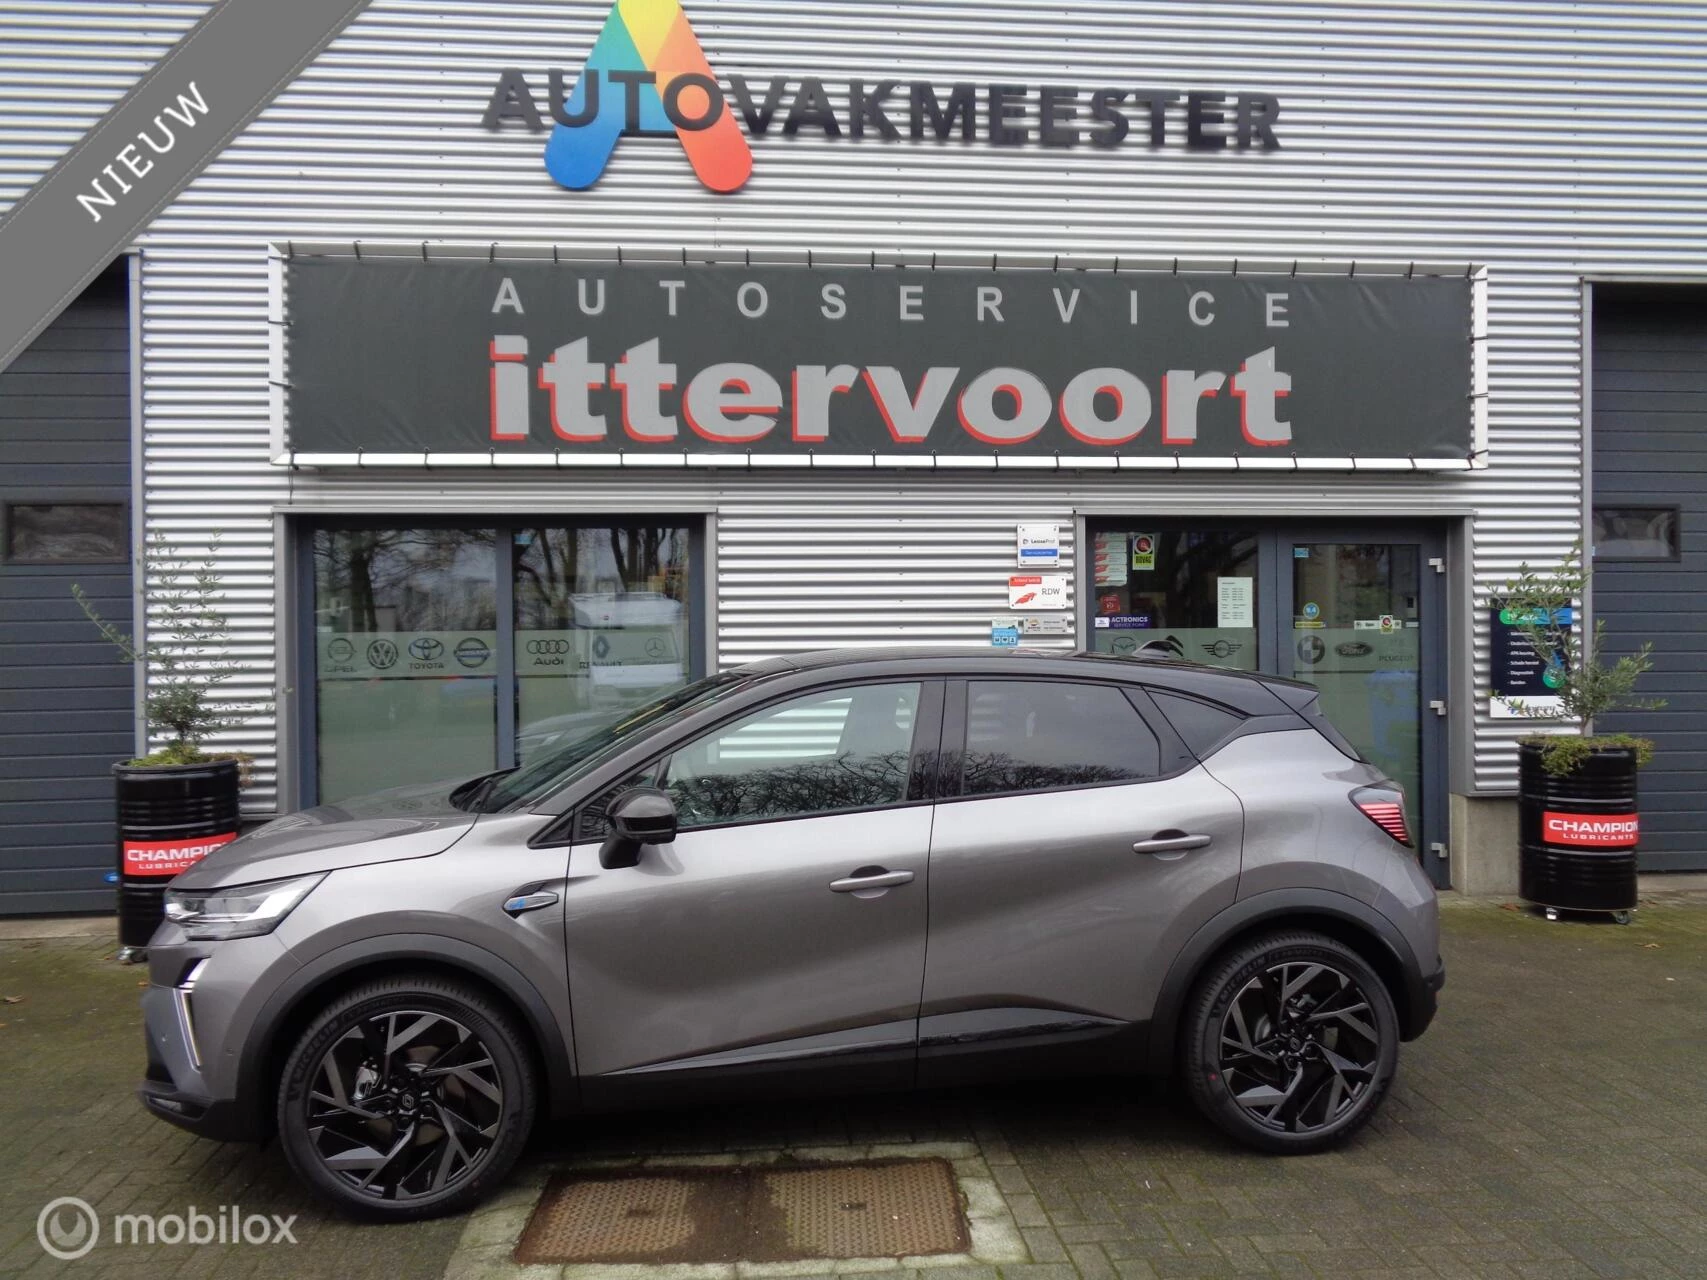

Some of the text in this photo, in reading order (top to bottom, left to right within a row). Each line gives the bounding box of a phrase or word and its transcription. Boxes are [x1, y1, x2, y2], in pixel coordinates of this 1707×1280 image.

[481, 67, 1281, 151] AUTOVAKMEESTER
[491, 277, 1290, 327] AUTOSERVICE
[489, 334, 1293, 447] ittervoort
[1041, 587, 1060, 595] RDW
[408, 662, 445, 670] TOYOTA
[533, 657, 565, 666] Audi
[1549, 819, 1638, 833] CHAMPION
[1563, 833, 1634, 841] LUBRICANTS
[127, 842, 228, 862] CHAMPI
